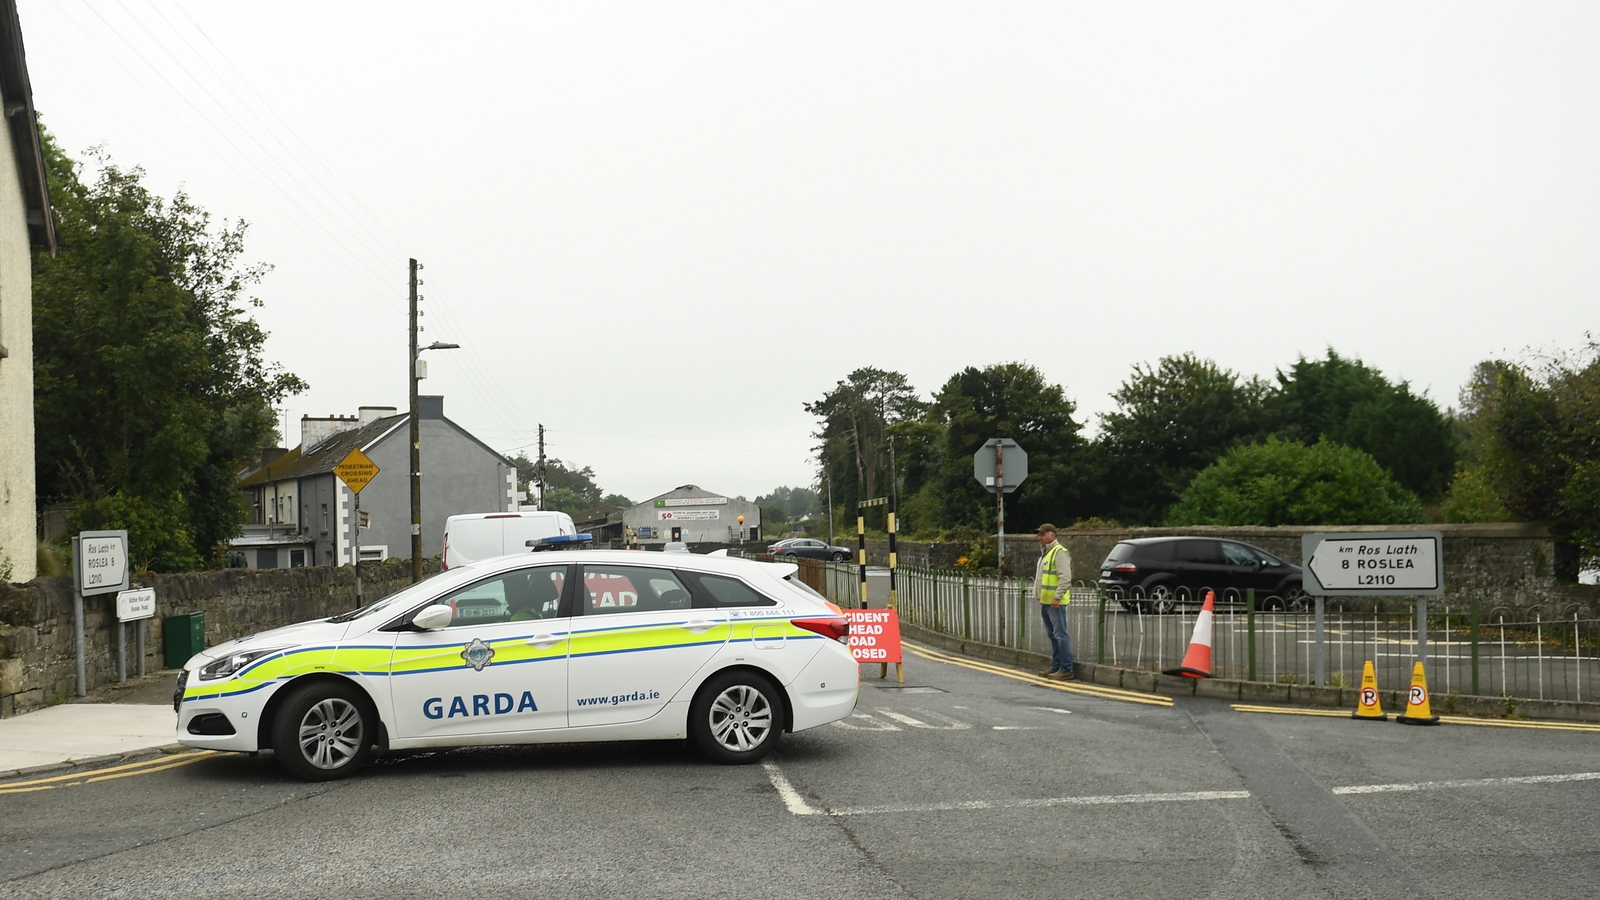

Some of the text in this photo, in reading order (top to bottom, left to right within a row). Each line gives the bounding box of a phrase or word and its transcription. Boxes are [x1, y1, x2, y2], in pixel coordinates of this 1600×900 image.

[88, 544, 97, 554] Ros
[98, 543, 109, 554] Liath
[1338, 544, 1418, 555] km Ros Liath
[88, 557, 115, 568] ROSLEA 8
[1341, 559, 1415, 570] 8 ROSLEA
[89, 573, 102, 584] L2110
[1358, 575, 1396, 585] L2110
[844, 612, 890, 623] CIDENT
[849, 624, 883, 635] HEAD
[848, 636, 877, 646] OAD
[852, 648, 888, 659] OSED
[577, 689, 660, 707] www.garda.ie
[422, 690, 539, 720] GARDA
